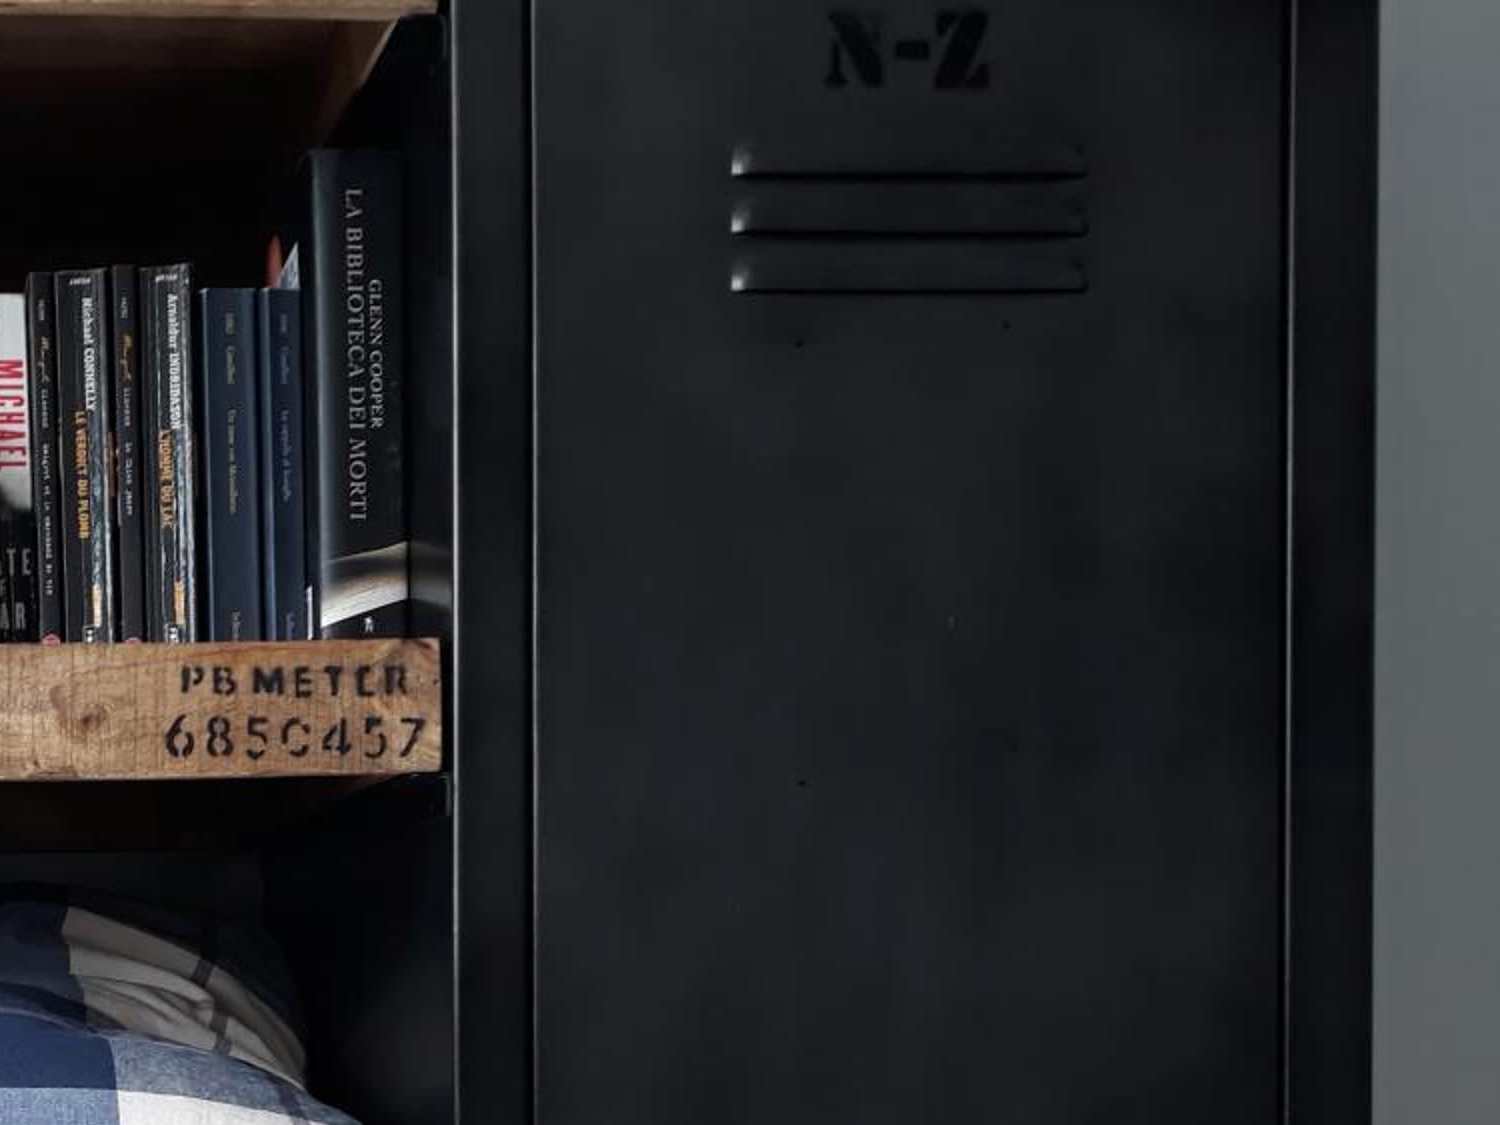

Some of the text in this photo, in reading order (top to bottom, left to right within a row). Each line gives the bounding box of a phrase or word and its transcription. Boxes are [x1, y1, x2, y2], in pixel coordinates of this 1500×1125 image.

[824, 11, 990, 89] N-Z
[82, 297, 97, 411] Michael CONNELLY
[167, 293, 180, 349] Arnaldur
[346, 188, 368, 520] LA BIBLIOTECA DEI MORTI
[369, 278, 385, 430] GLENN COOPER
